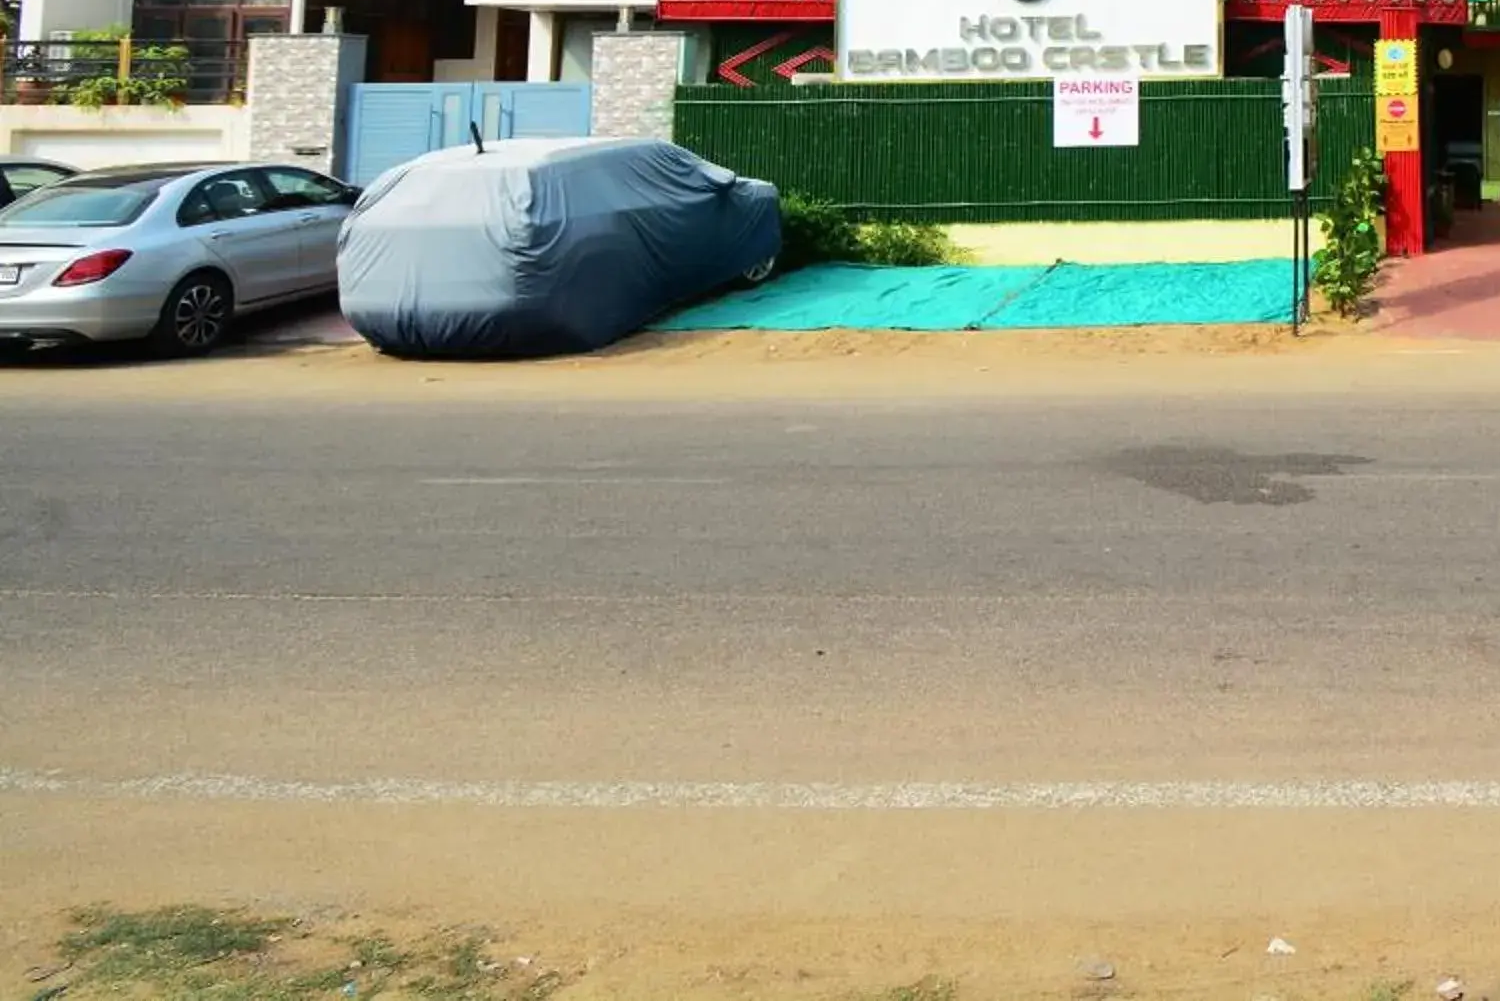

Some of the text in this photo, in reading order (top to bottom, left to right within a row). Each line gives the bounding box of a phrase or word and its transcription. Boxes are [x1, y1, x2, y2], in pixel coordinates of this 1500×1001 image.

[959, 13, 1101, 43] HOTEL
[847, 44, 1210, 74] BAMBOO CASTLE
[1059, 80, 1133, 94] PARKING
